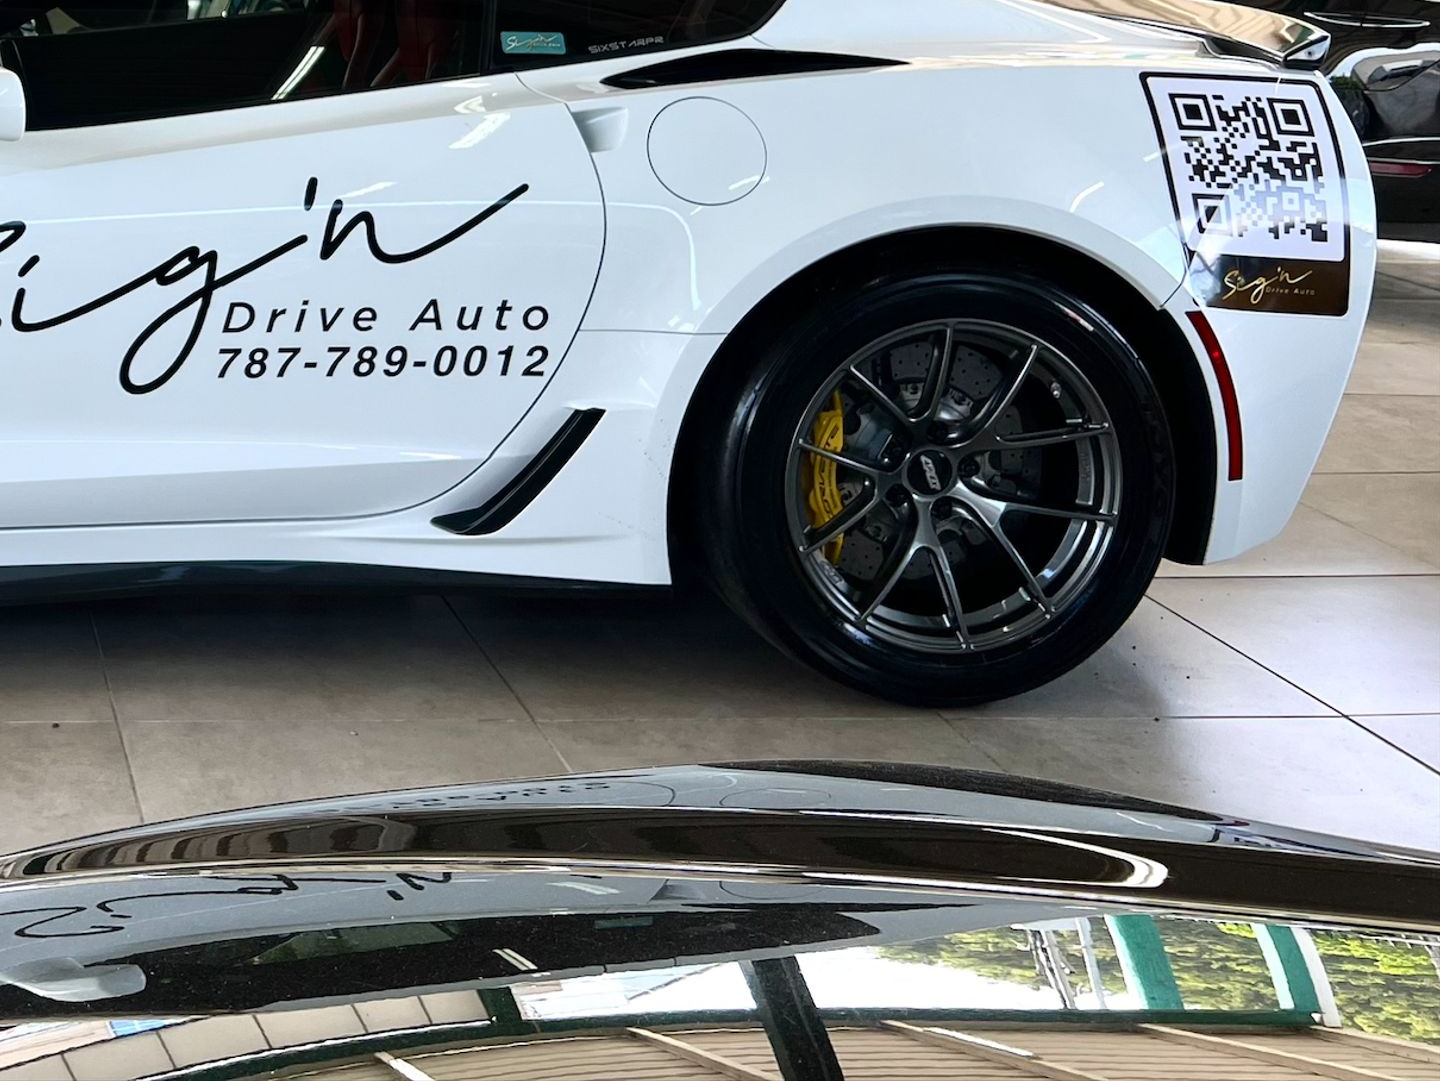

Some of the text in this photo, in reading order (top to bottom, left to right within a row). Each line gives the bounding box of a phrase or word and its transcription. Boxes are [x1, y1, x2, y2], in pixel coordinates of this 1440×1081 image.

[222, 298, 550, 333] Drive Auto
[216, 344, 550, 379] 787-789-0012
